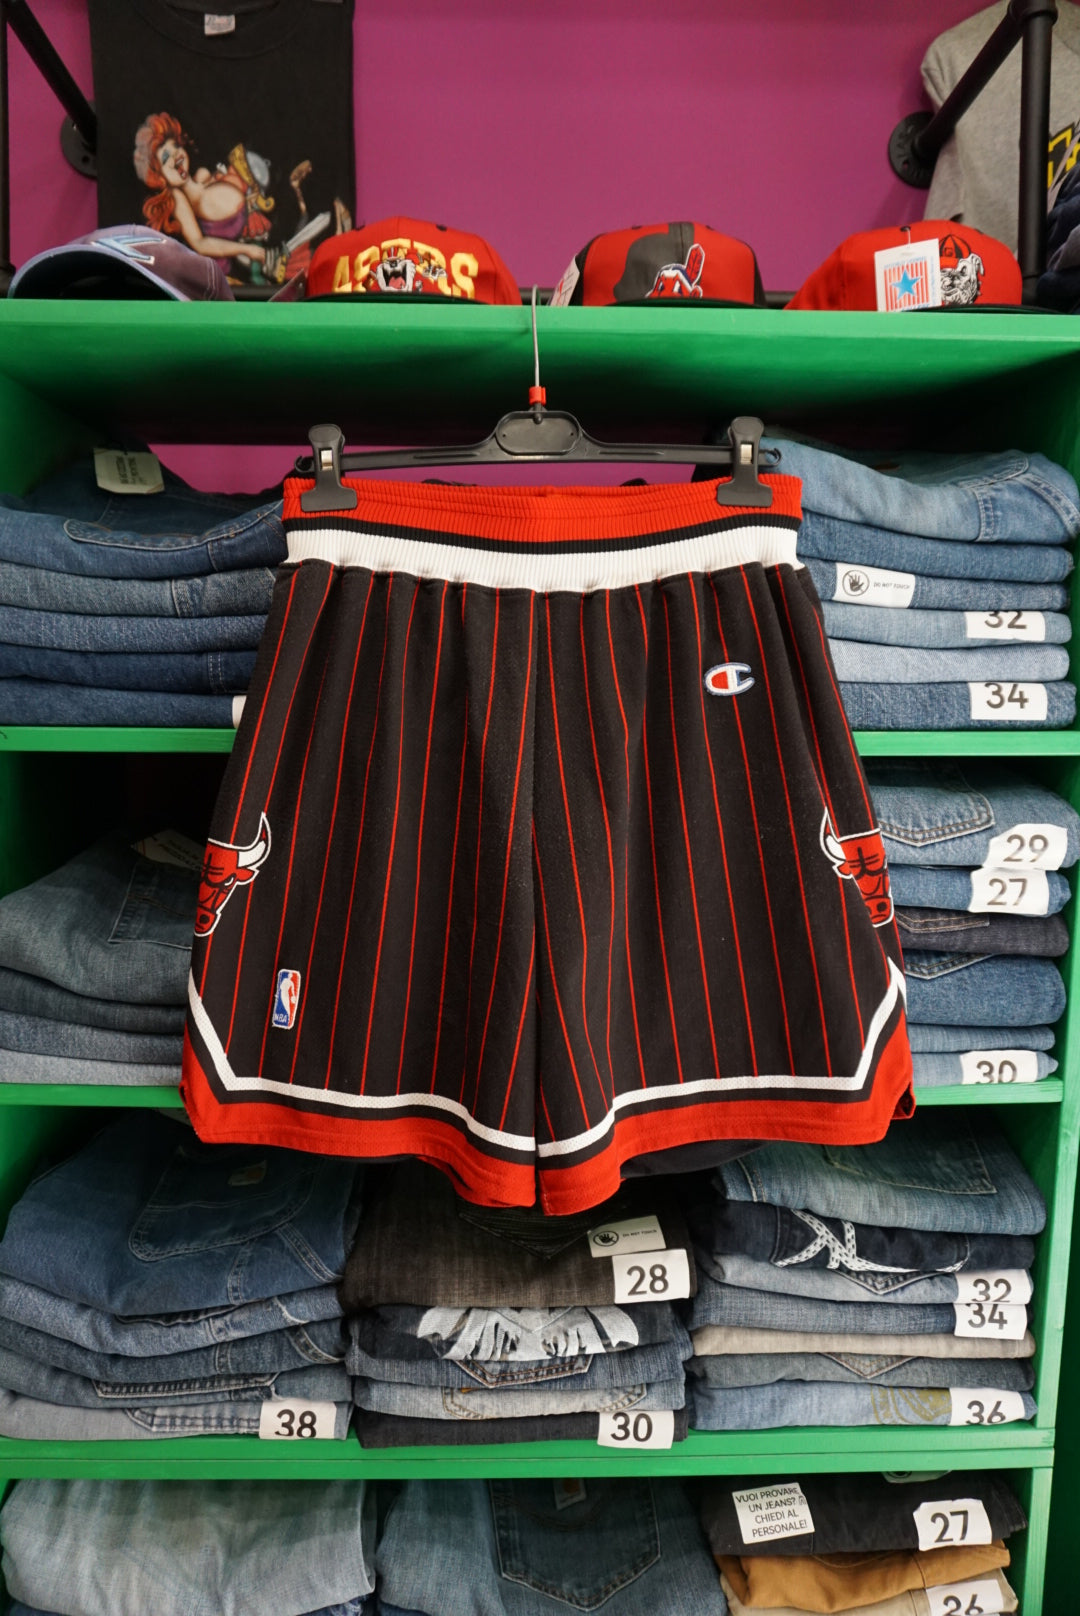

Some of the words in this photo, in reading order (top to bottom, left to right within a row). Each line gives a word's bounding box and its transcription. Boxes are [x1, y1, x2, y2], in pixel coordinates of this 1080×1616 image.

[984, 682, 1029, 709] 34
[1003, 834, 1049, 863] 29
[987, 878, 1028, 906] 27
[274, 1013, 287, 1023] NBA
[976, 1060, 1017, 1084] 30
[627, 1264, 669, 1296] 28
[971, 1278, 1012, 1302] 32
[965, 1303, 1008, 1330] 34
[275, 1409, 317, 1438] 38
[966, 1400, 1006, 1424] 36
[610, 1411, 653, 1442] 30
[736, 1493, 758, 1503] VUOI
[760, 1487, 799, 1499] PROVARE
[748, 1503, 763, 1512] UN
[765, 1497, 796, 1510] JEANS?
[755, 1511, 785, 1524] CHIEDI
[787, 1508, 799, 1518] AL
[930, 1510, 968, 1543] 27
[752, 1519, 808, 1538] PERSONALE!
[943, 1593, 984, 1616] 26
